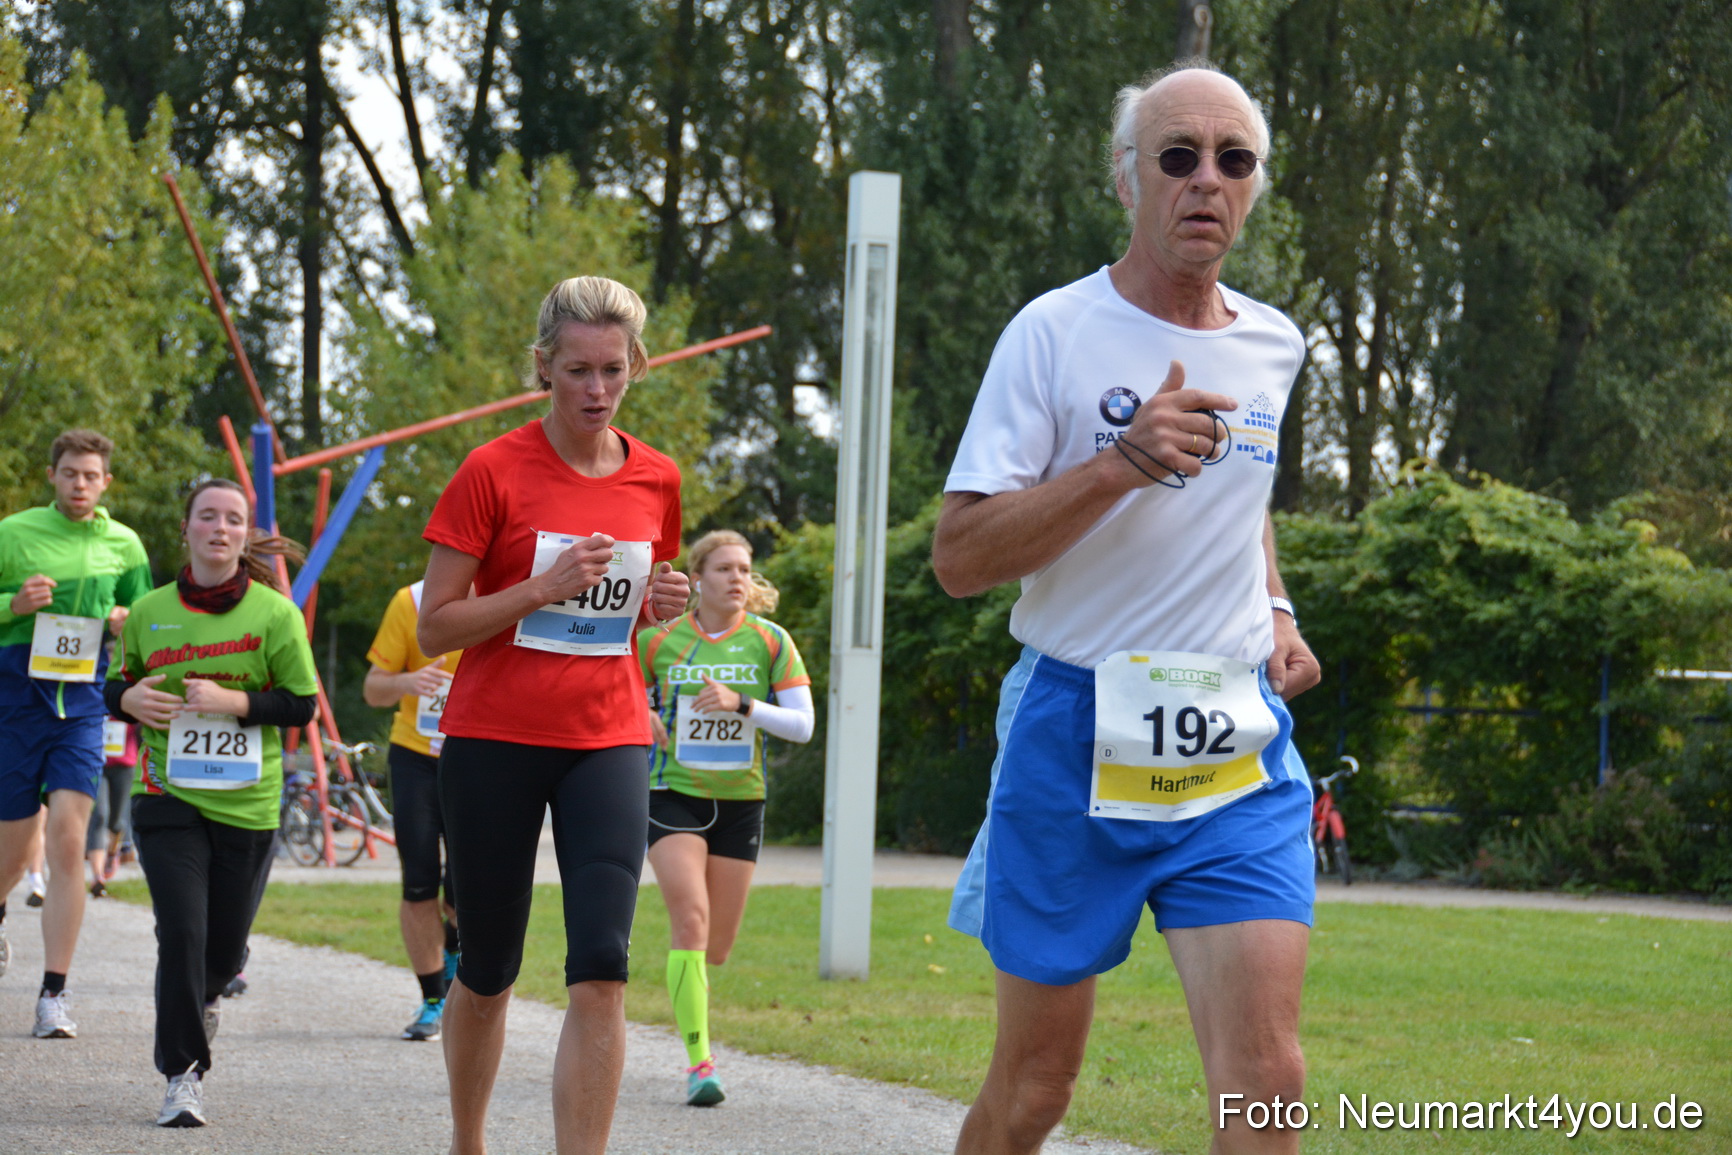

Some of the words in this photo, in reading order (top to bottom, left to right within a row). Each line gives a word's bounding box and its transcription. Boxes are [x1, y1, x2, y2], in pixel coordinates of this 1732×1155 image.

[1102, 388, 1137, 401] BMW
[551, 577, 632, 611] 409
[568, 621, 596, 635] Julia
[56, 636, 81, 656] 83
[668, 664, 759, 684] BOCK
[1168, 668, 1221, 687] BOCK
[689, 718, 743, 741] 2782
[1143, 705, 1236, 757] 192
[182, 730, 248, 757] 2128
[1105, 748, 1112, 757] D
[204, 764, 224, 774] Lisa
[1150, 770, 1217, 793] Hartmut
